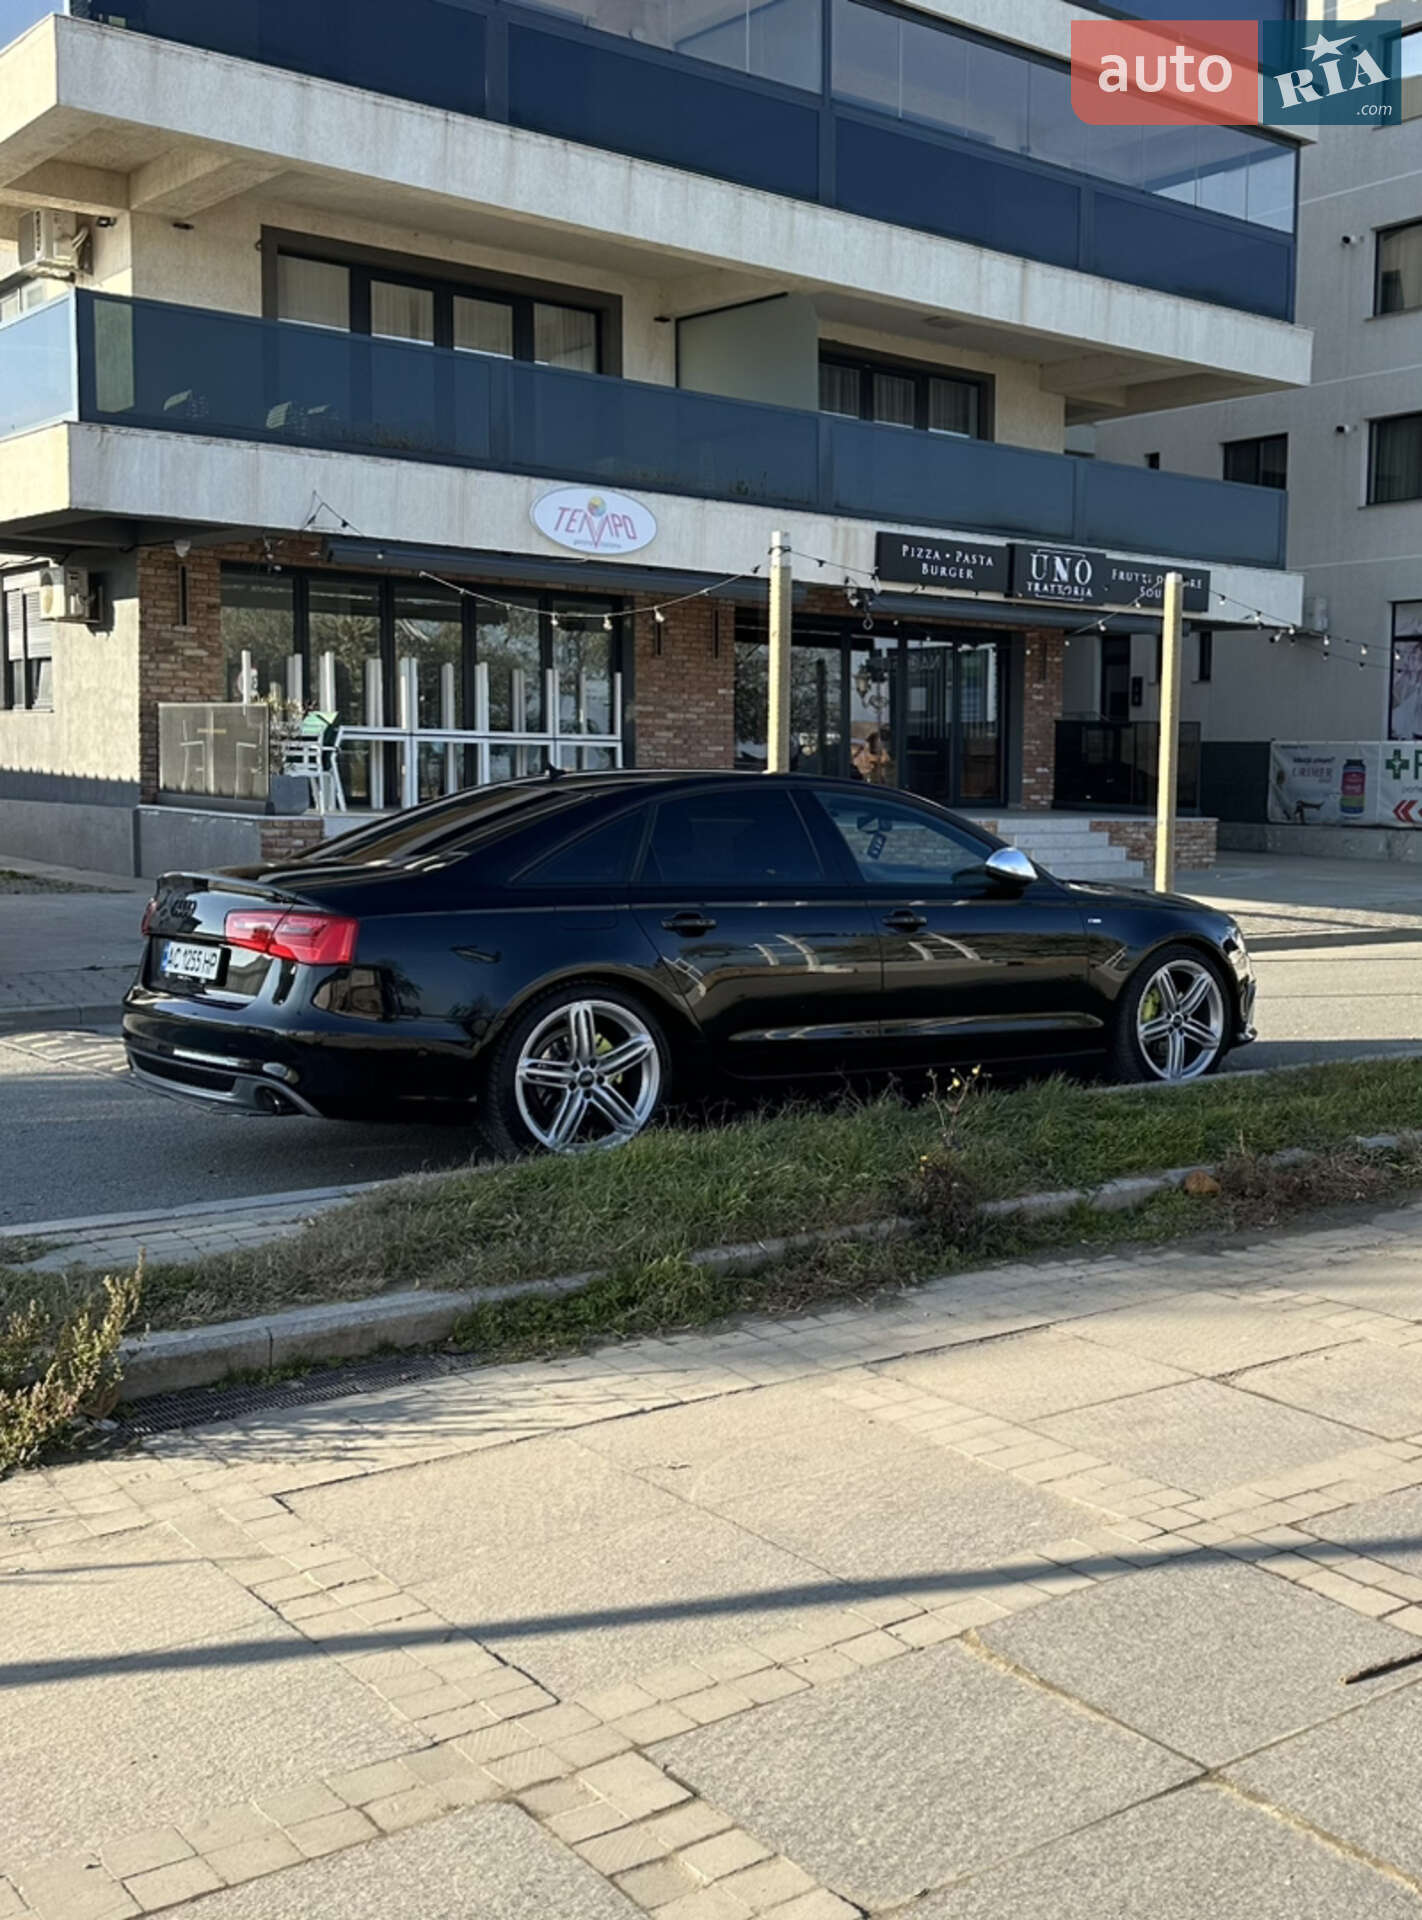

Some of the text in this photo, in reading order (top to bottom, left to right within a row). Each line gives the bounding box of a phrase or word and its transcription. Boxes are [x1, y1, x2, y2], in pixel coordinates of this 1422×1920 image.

[554, 506, 637, 549] TEMPO
[902, 544, 994, 567] PIZZA PASTA
[922, 563, 974, 580] BURGER
[1029, 553, 1093, 586] UNO
[1026, 581, 1093, 598] TRATTORIA
